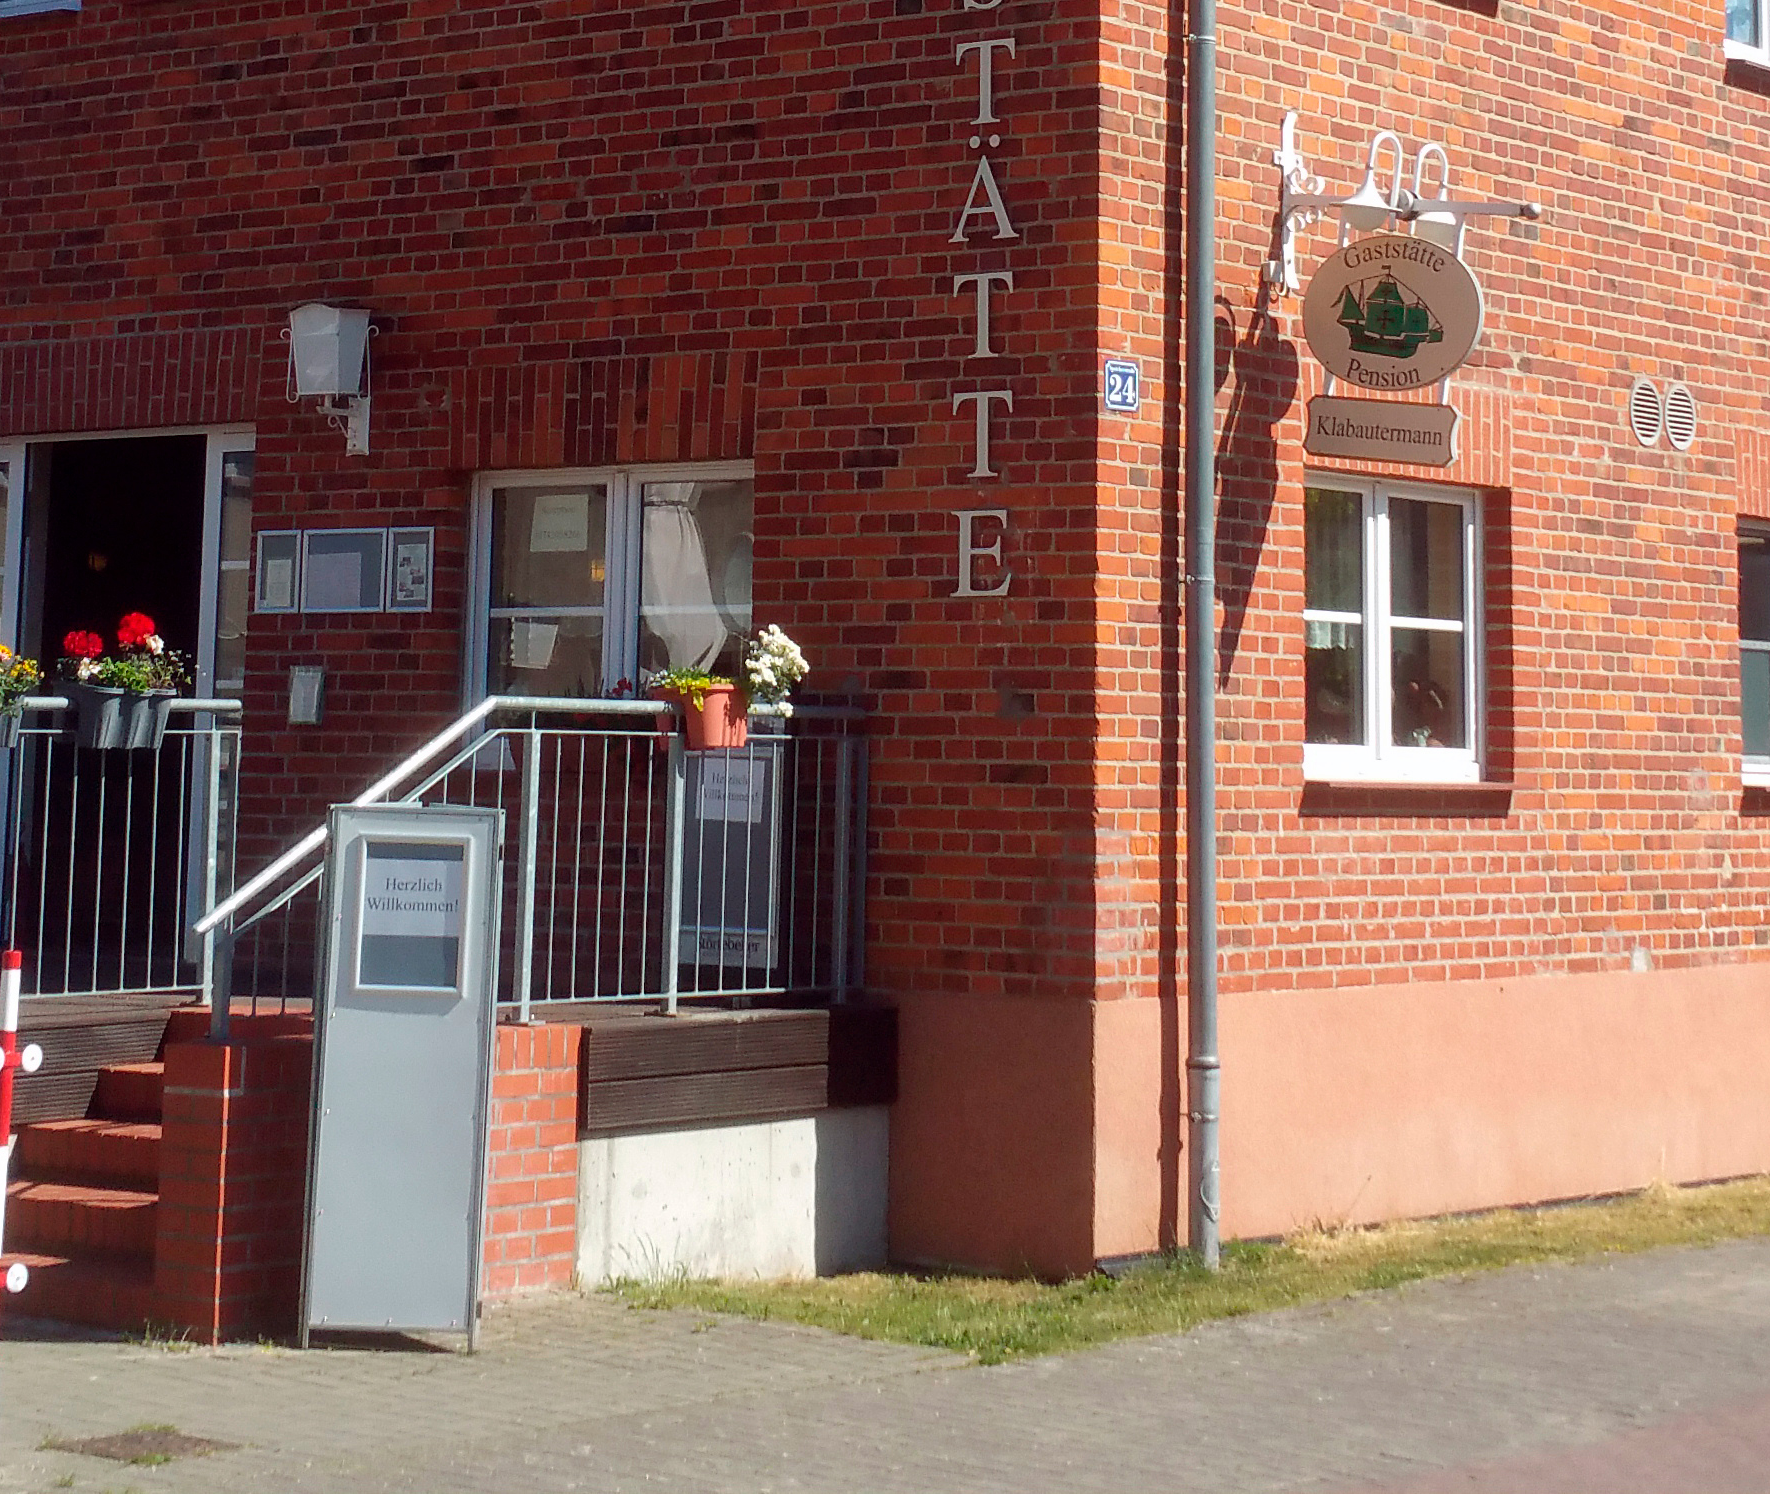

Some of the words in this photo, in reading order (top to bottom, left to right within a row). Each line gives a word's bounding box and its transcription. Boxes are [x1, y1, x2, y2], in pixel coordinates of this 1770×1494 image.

[1343, 240, 1446, 273] Gaststätte
[1109, 373, 1135, 403] 24
[1345, 358, 1422, 388] Pension
[1317, 415, 1443, 446] Klabautermann
[385, 877, 442, 892] Herzlich
[367, 896, 459, 913] Willkommen!
